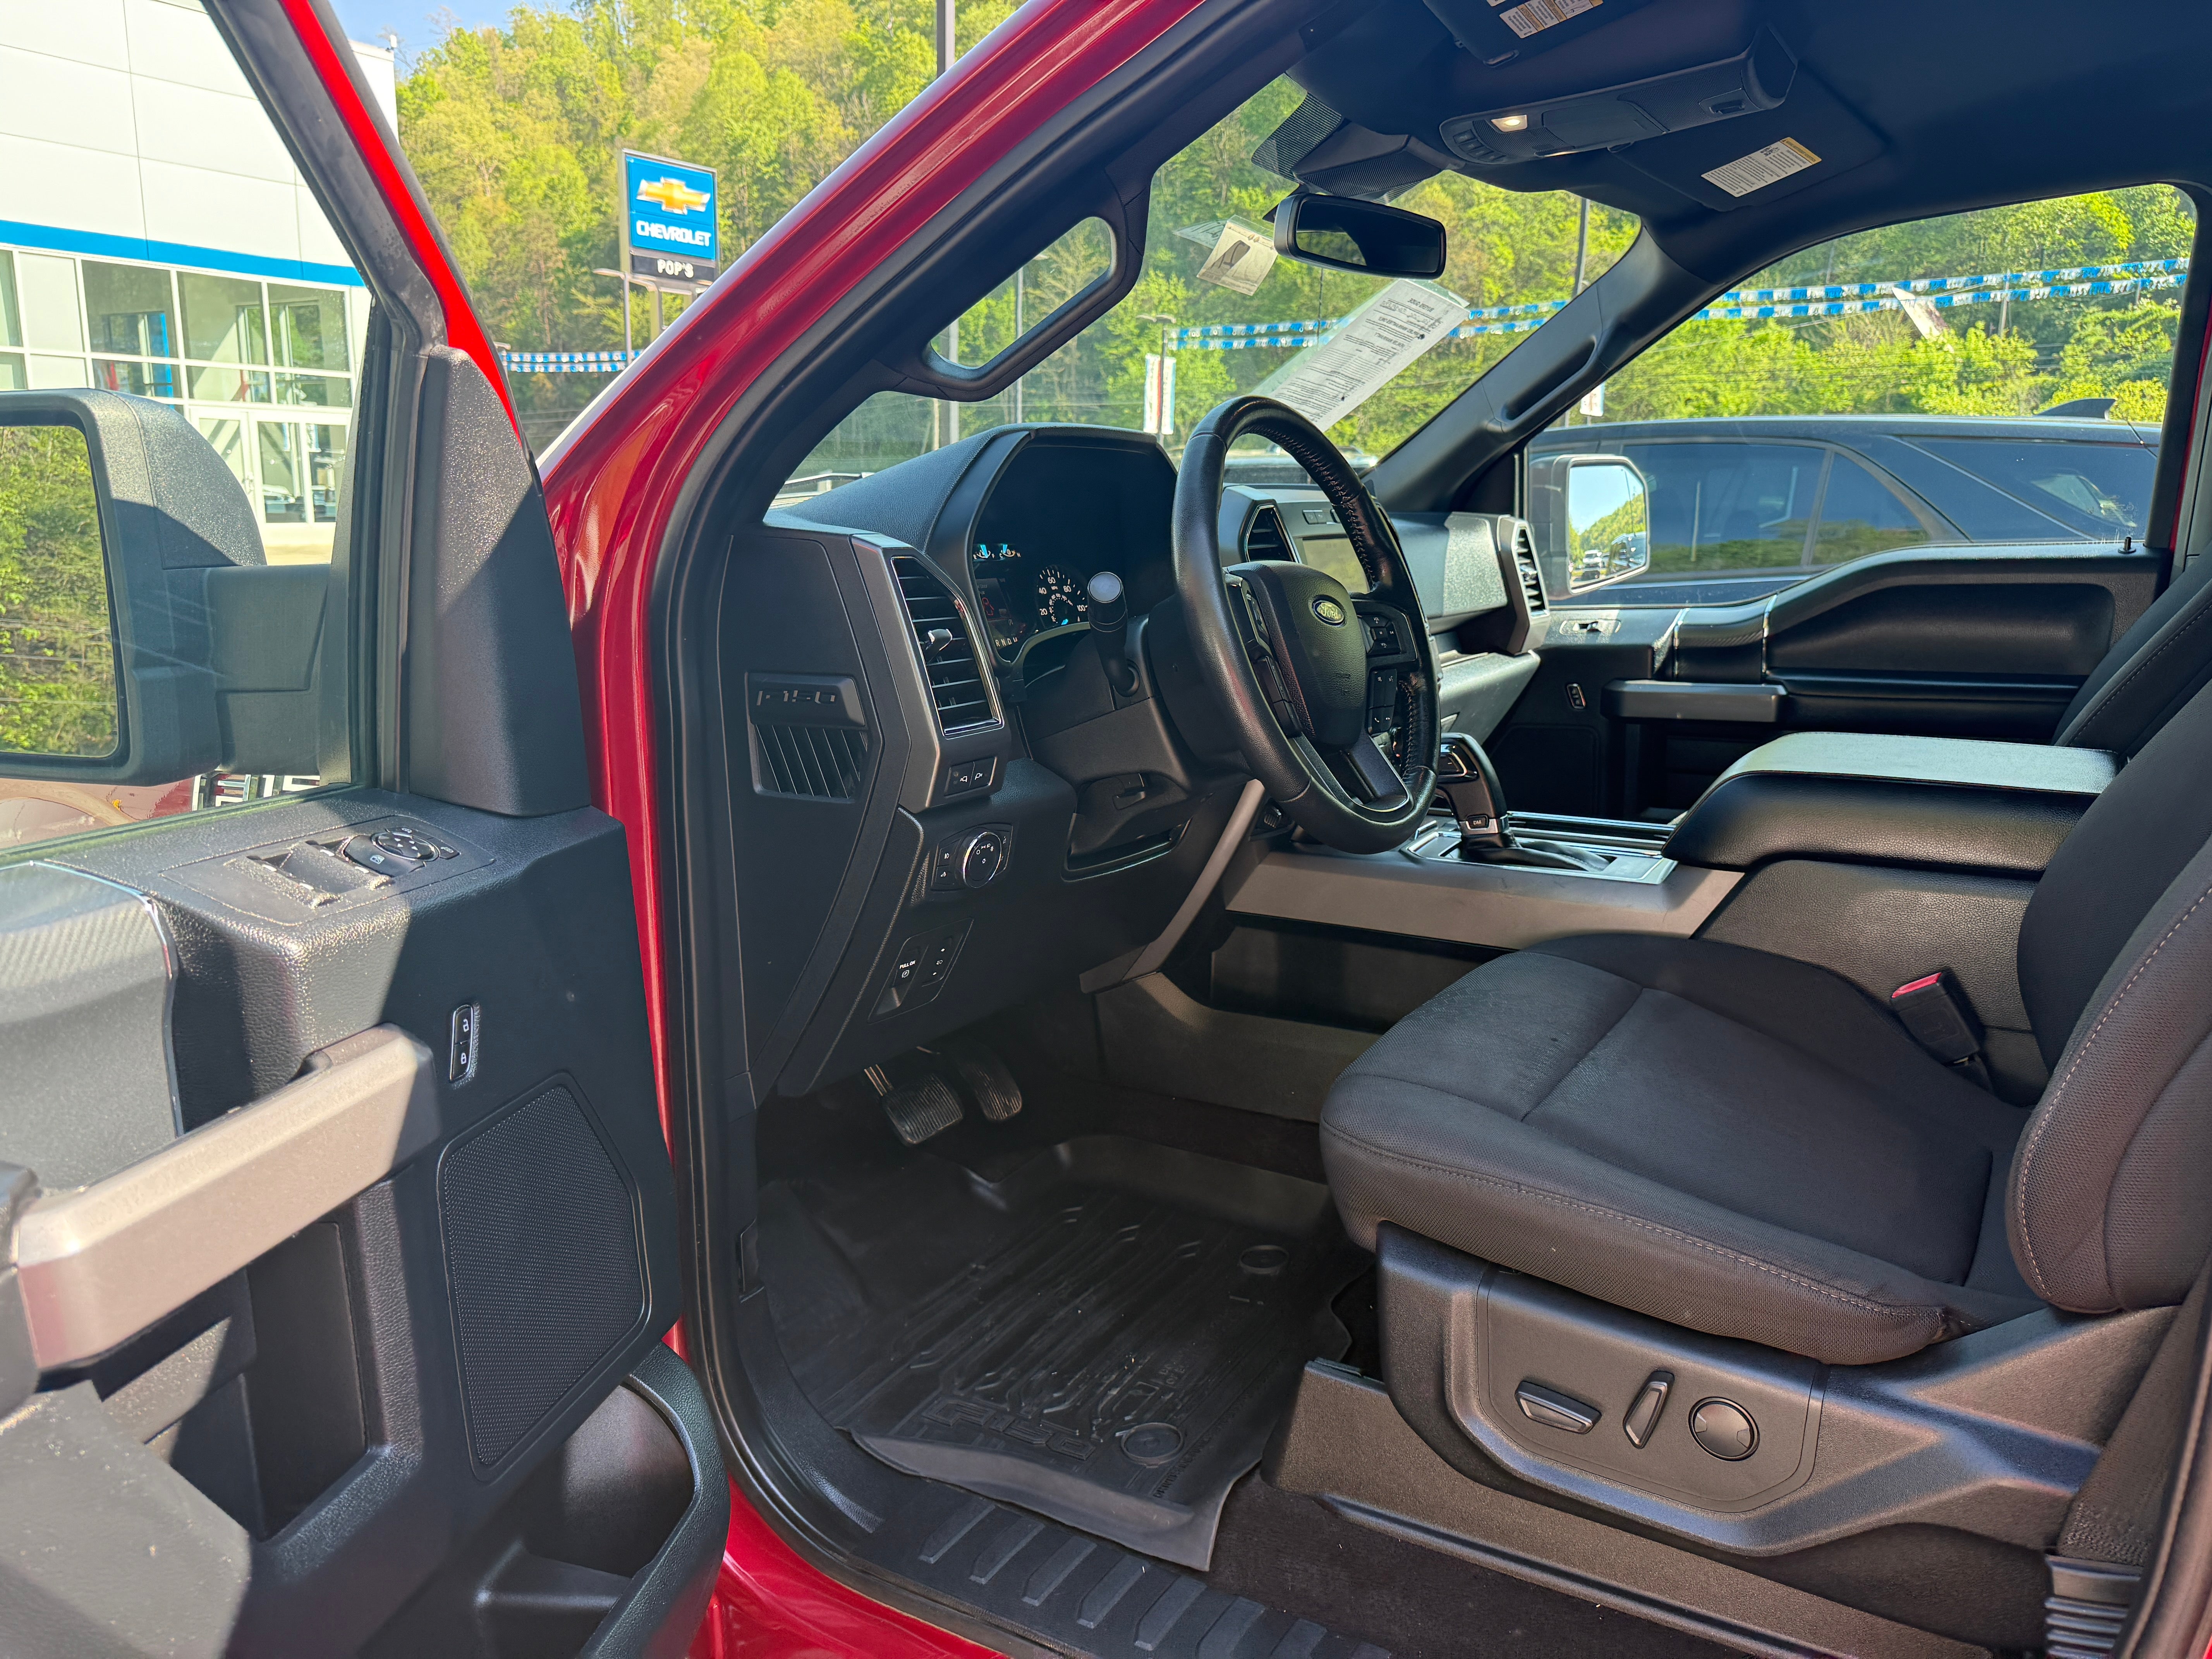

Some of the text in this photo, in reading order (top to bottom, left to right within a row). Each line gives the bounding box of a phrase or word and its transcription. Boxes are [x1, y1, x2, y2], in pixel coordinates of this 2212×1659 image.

[636, 220, 711, 246] CHEVROLET
[657, 259, 694, 278] POP'S
[1321, 603, 1339, 620] Ford
